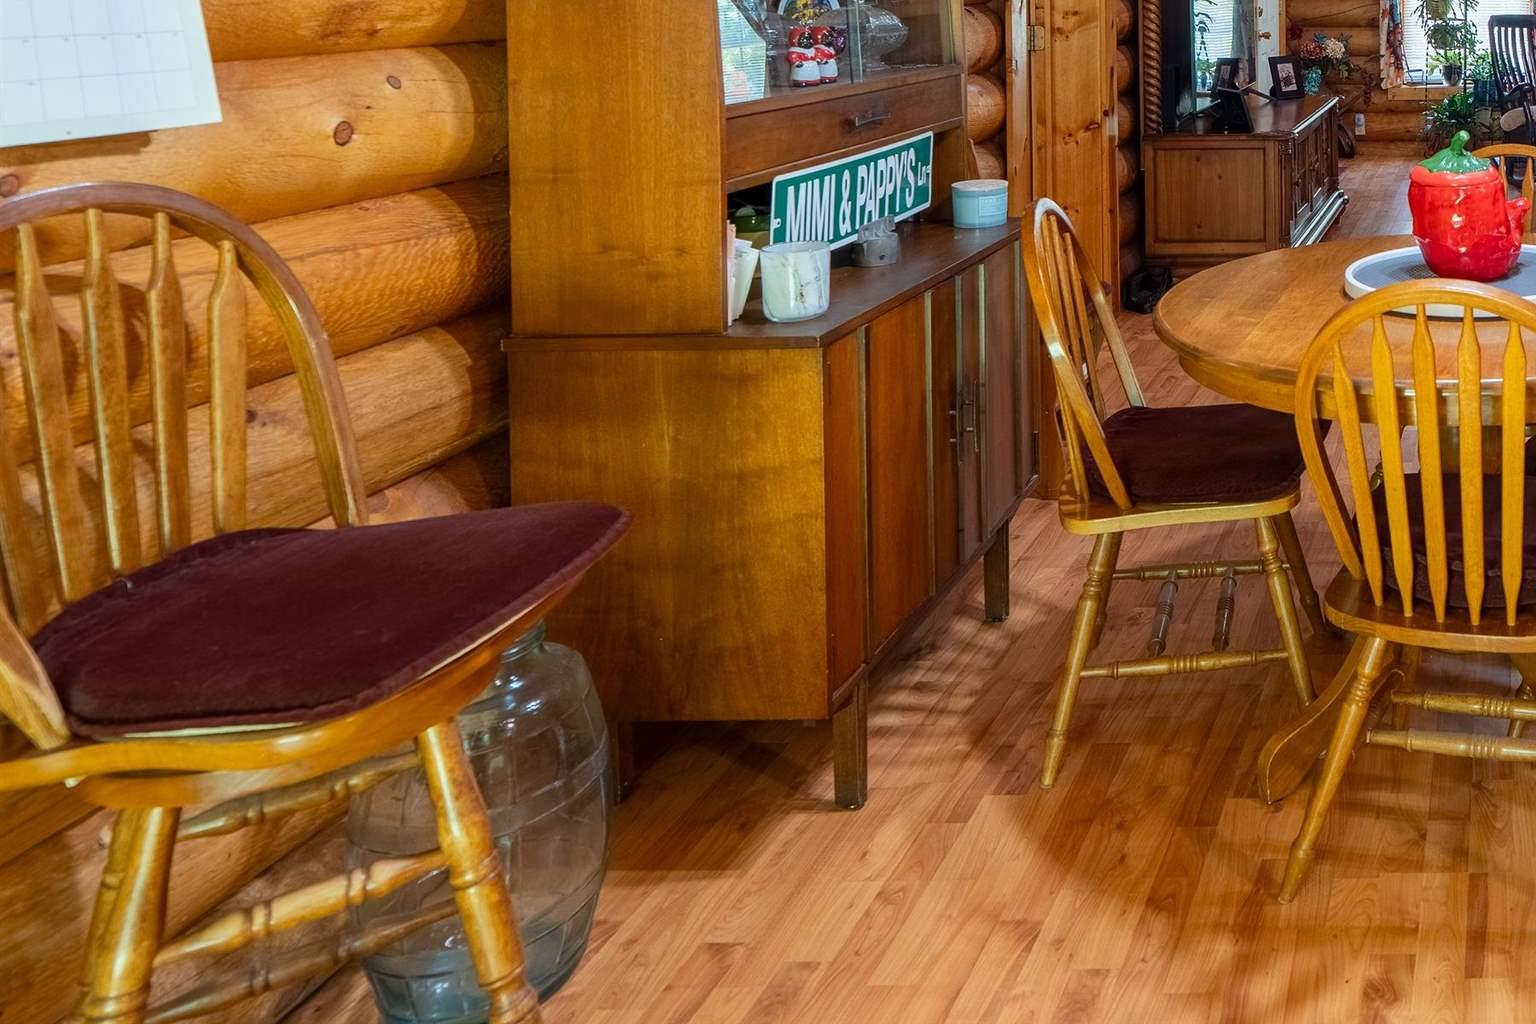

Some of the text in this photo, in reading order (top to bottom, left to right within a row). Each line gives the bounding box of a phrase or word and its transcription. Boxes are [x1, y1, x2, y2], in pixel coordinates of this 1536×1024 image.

[785, 173, 836, 242] MIMI
[838, 169, 852, 236] &
[855, 147, 916, 229] PAPPY'S
